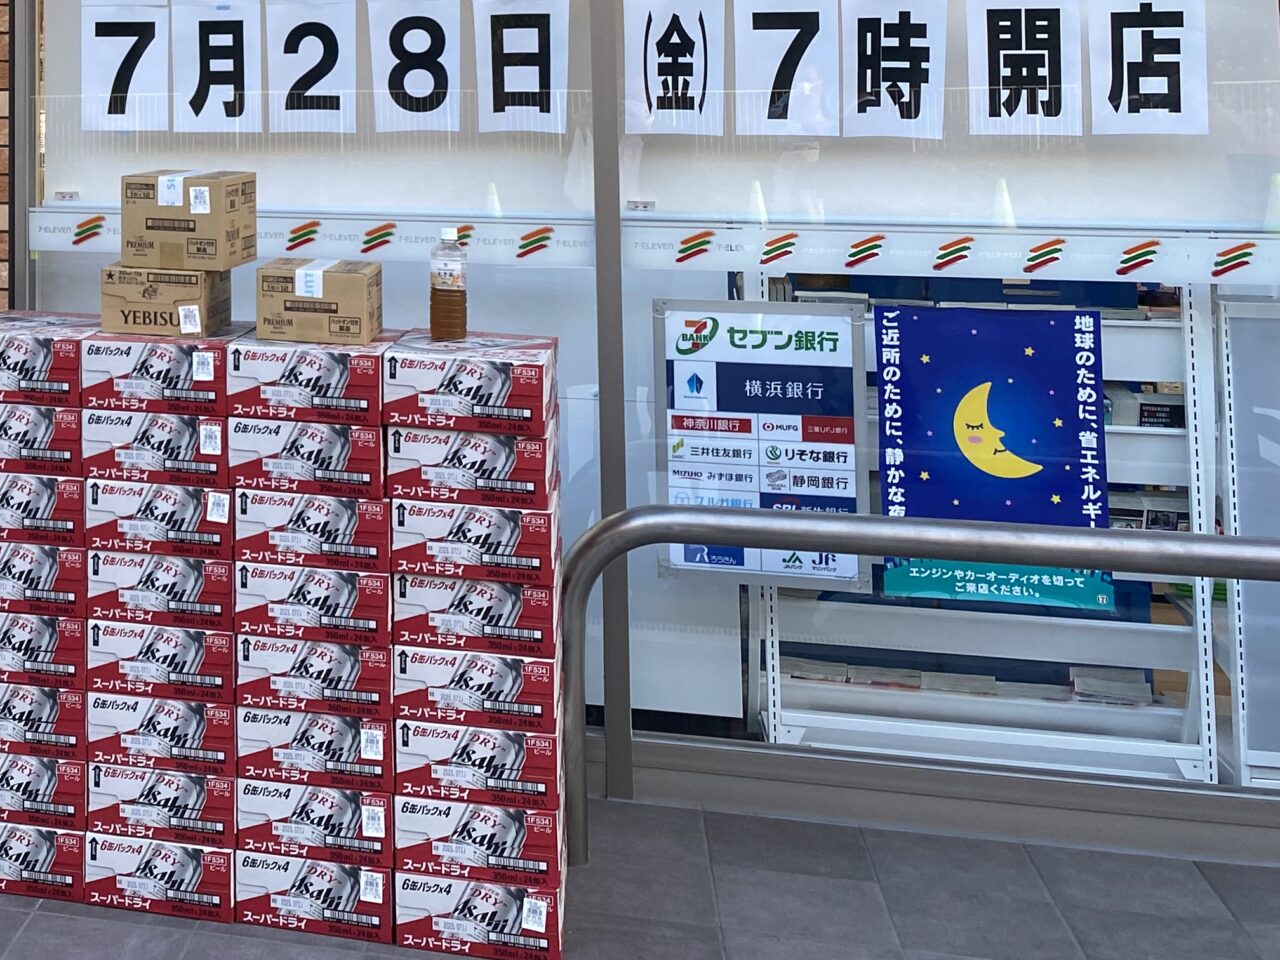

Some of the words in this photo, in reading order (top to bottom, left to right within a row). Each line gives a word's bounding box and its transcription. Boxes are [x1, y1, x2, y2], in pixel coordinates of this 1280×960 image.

[126, 239, 155, 249] PREMIUM
[120, 310, 180, 328] YEBISU
[263, 317, 293, 327] PREMIUM
[681, 333, 710, 343] BANK
[726, 326, 839, 353] セブン銀行
[744, 379, 825, 400] 横浜銀行
[88, 396, 148, 410] スーパードライ
[389, 413, 456, 428] スーパードライ
[683, 418, 740, 431] 神奈川銀行
[690, 446, 753, 459] 三井住友銀行
[785, 448, 848, 464] りそな銀行
[235, 476, 299, 490] スーパードライ
[672, 469, 703, 478] MIZUHO
[707, 471, 753, 483] みずほ銀行
[792, 474, 849, 490] 静岡銀行
[397, 561, 464, 576] スーパードライ
[909, 566, 1085, 588] エンジンやカーオーディオを切って
[955, 581, 1041, 599] ご来店ください。
[93, 607, 153, 621] スーパードライ
[243, 695, 307, 709] スーパードライ
[403, 861, 470, 876] スーパードライ
[91, 894, 151, 908] スーパードライ
